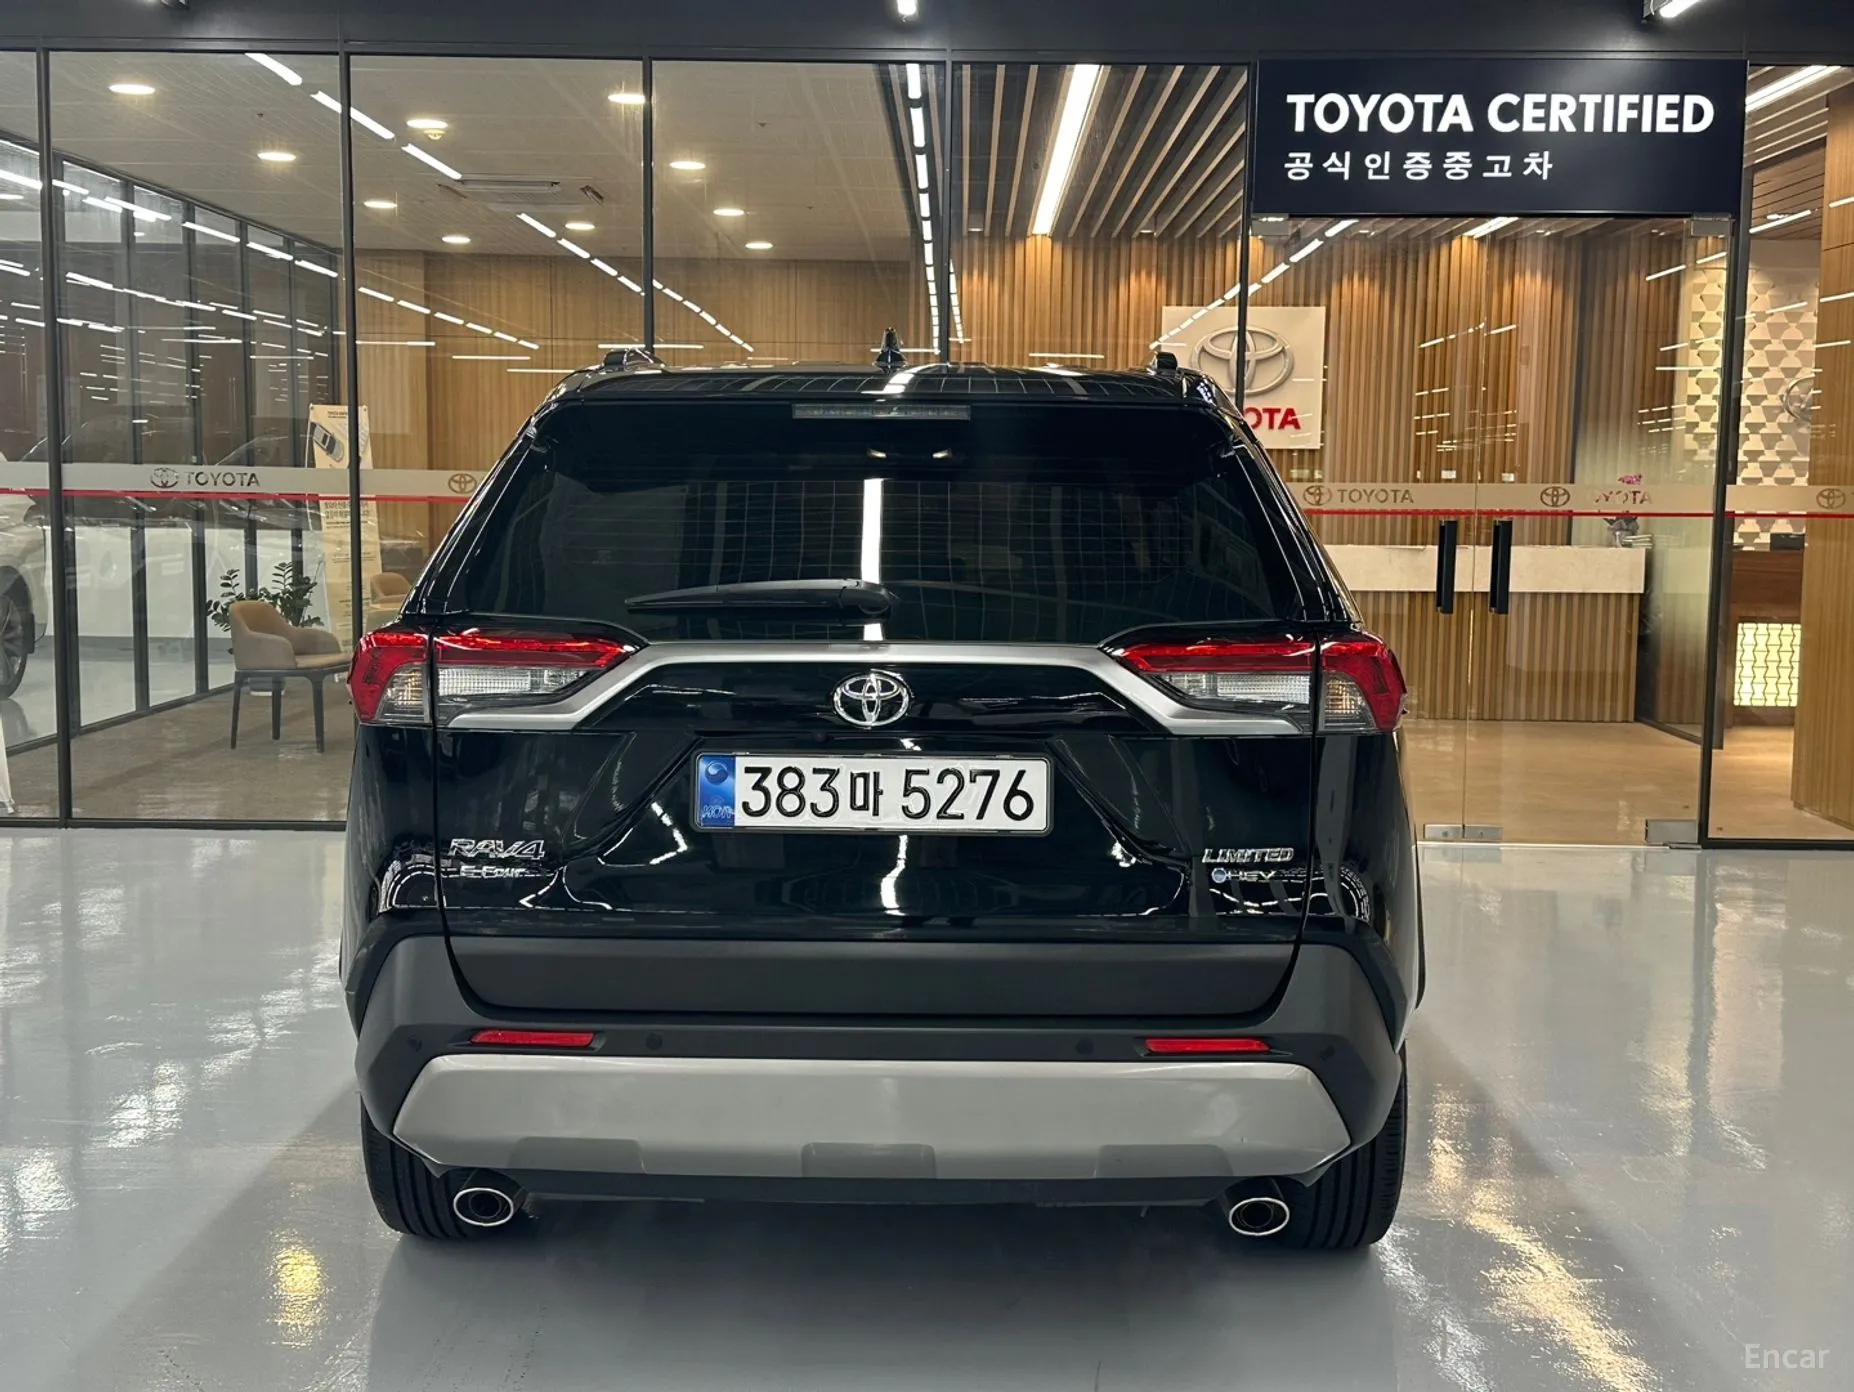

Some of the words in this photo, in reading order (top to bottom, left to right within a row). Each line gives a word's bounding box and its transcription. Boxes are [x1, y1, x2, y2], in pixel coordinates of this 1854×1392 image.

[1286, 93, 1473, 133] TOYOTA
[1487, 93, 1714, 133] CERTIFIED
[1245, 407, 1301, 430] OTA
[185, 472, 260, 486] TOYOTA
[1337, 489, 1414, 503] TOYOTA
[741, 766, 883, 818] 383마
[901, 768, 1034, 821] 5276
[448, 838, 545, 860] RAV4
[1202, 848, 1294, 863] LIMITED
